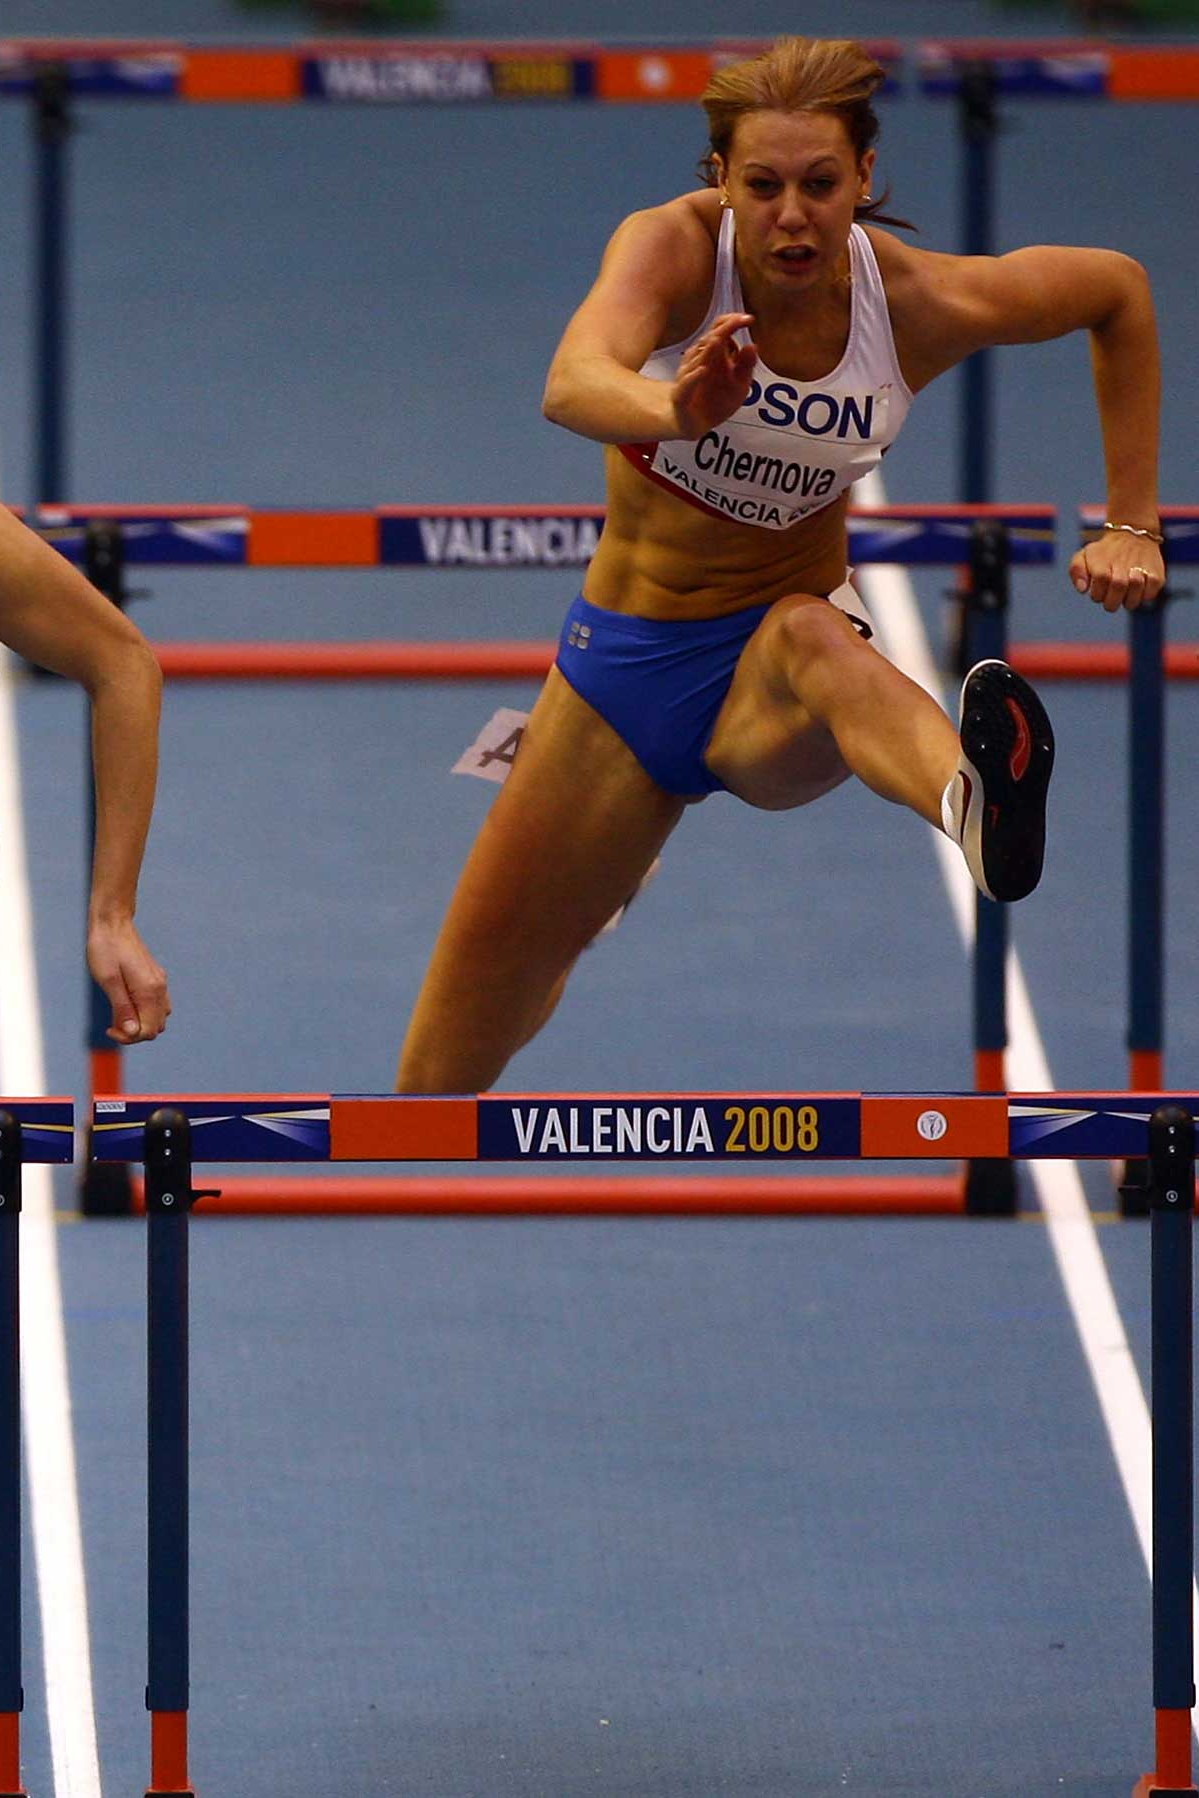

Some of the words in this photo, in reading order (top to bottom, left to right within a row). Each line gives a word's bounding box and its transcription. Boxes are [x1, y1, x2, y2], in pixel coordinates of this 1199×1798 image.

[742, 378, 874, 439] SON
[663, 458, 783, 526] VALENCIA
[694, 431, 836, 497] Chernova
[419, 517, 602, 562] VALENCIA
[511, 1107, 715, 1153] VALENCIA
[724, 1106, 819, 1153] 2008
